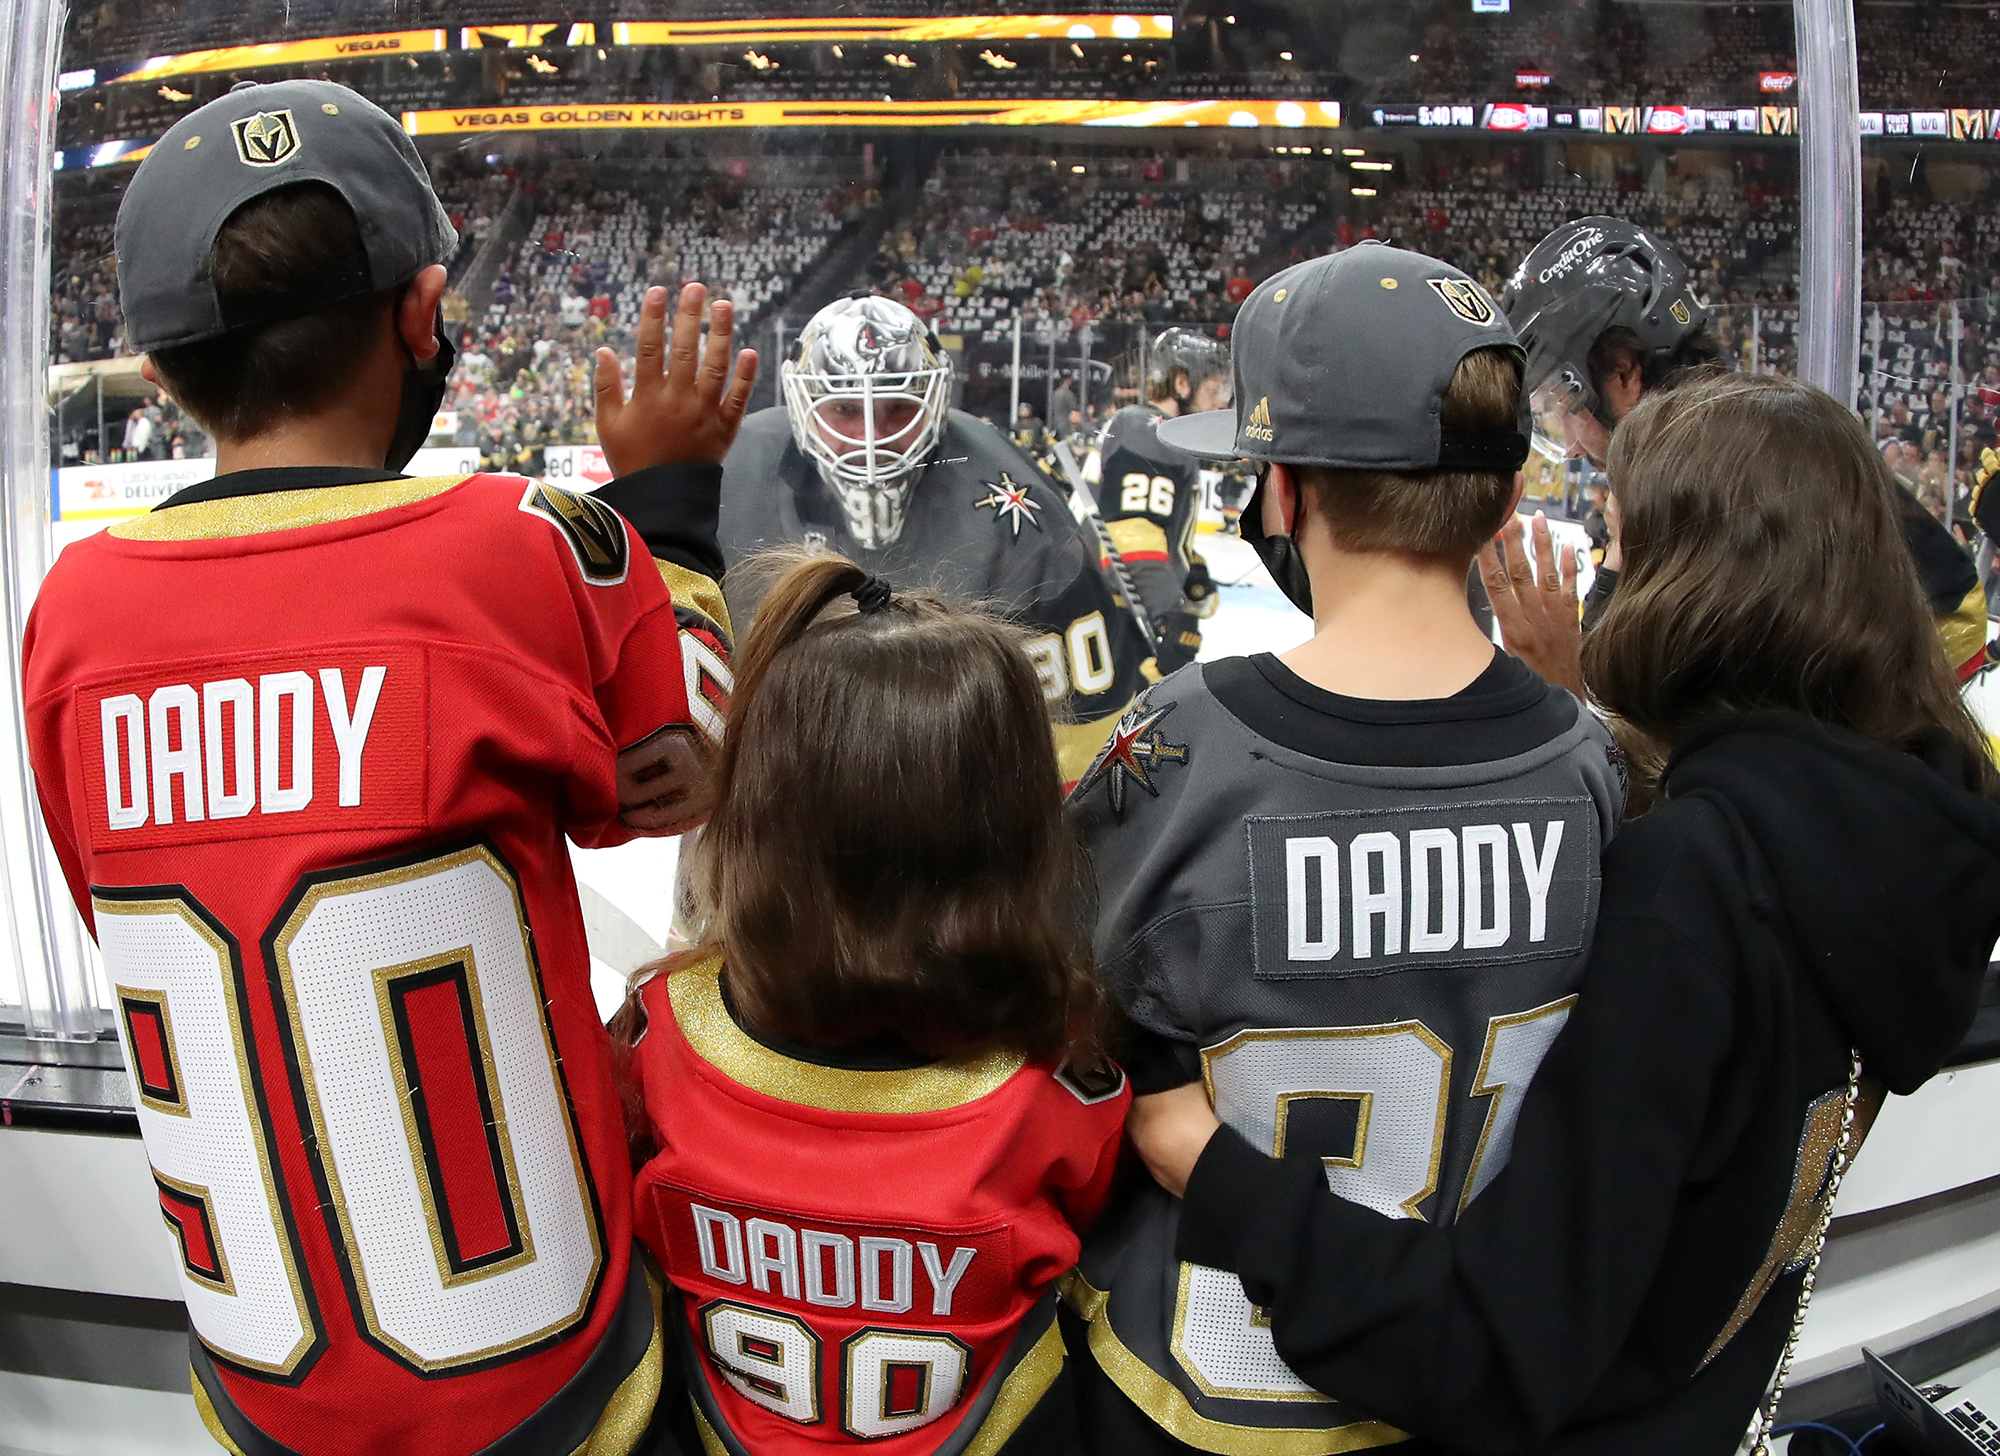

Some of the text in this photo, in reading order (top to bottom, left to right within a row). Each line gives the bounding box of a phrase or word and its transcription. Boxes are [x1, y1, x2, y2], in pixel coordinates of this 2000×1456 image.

[335, 39, 401, 53] VEGAS
[453, 108, 745, 126] VEGAS GOLDEN KNIGHTS
[1418, 106, 1450, 126] 5:40
[1451, 106, 1474, 126] PM
[1245, 423, 1274, 442] adidas
[1121, 472, 1176, 518] 26
[100, 665, 387, 831] DADDY
[1285, 820, 1565, 962] DADDY
[93, 838, 604, 1384] 90
[690, 1203, 978, 1316] DADDY
[698, 1297, 974, 1441] 90
